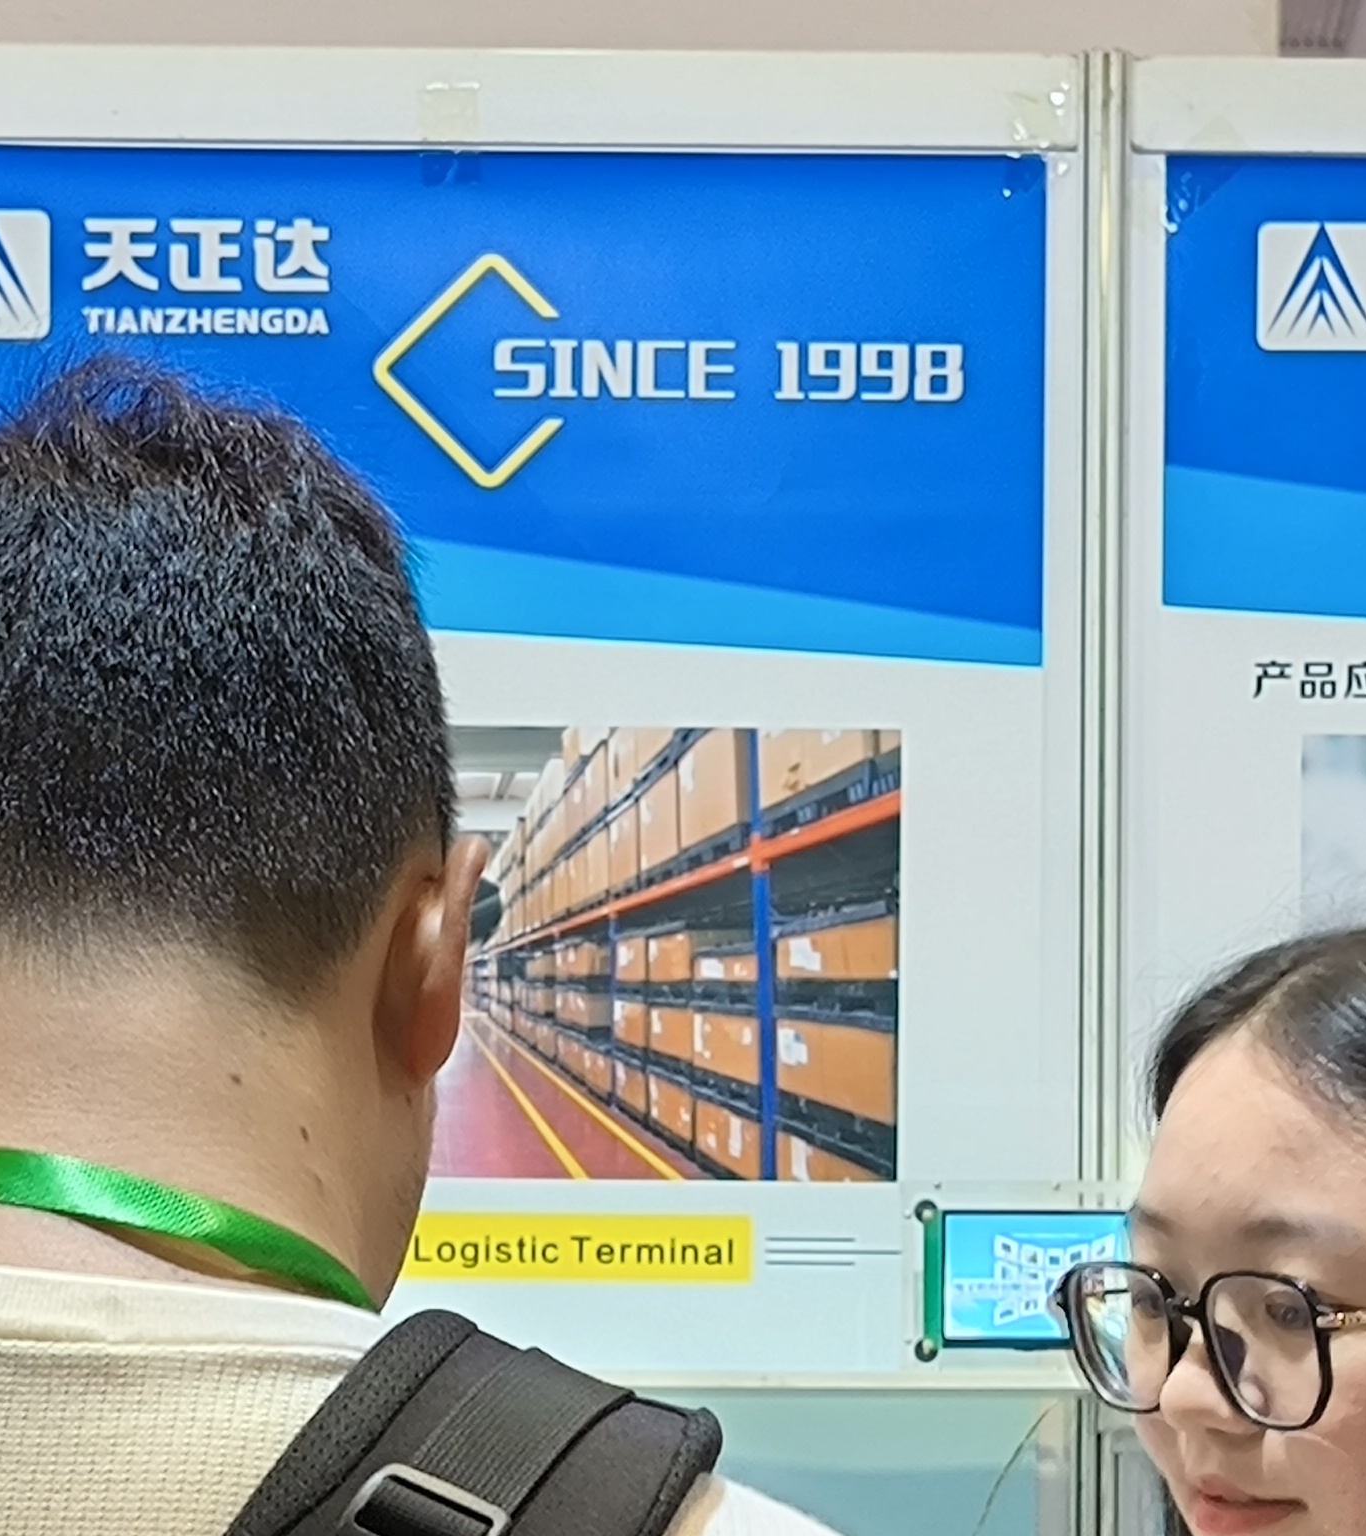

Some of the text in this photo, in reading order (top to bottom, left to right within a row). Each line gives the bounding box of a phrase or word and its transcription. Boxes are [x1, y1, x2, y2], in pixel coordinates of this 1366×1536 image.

[81, 217, 333, 293] 天正达
[82, 306, 330, 336] TIANZHENGDA
[492, 340, 966, 402] SINCE 1998
[414, 1236, 735, 1268] Logistic Terminal
